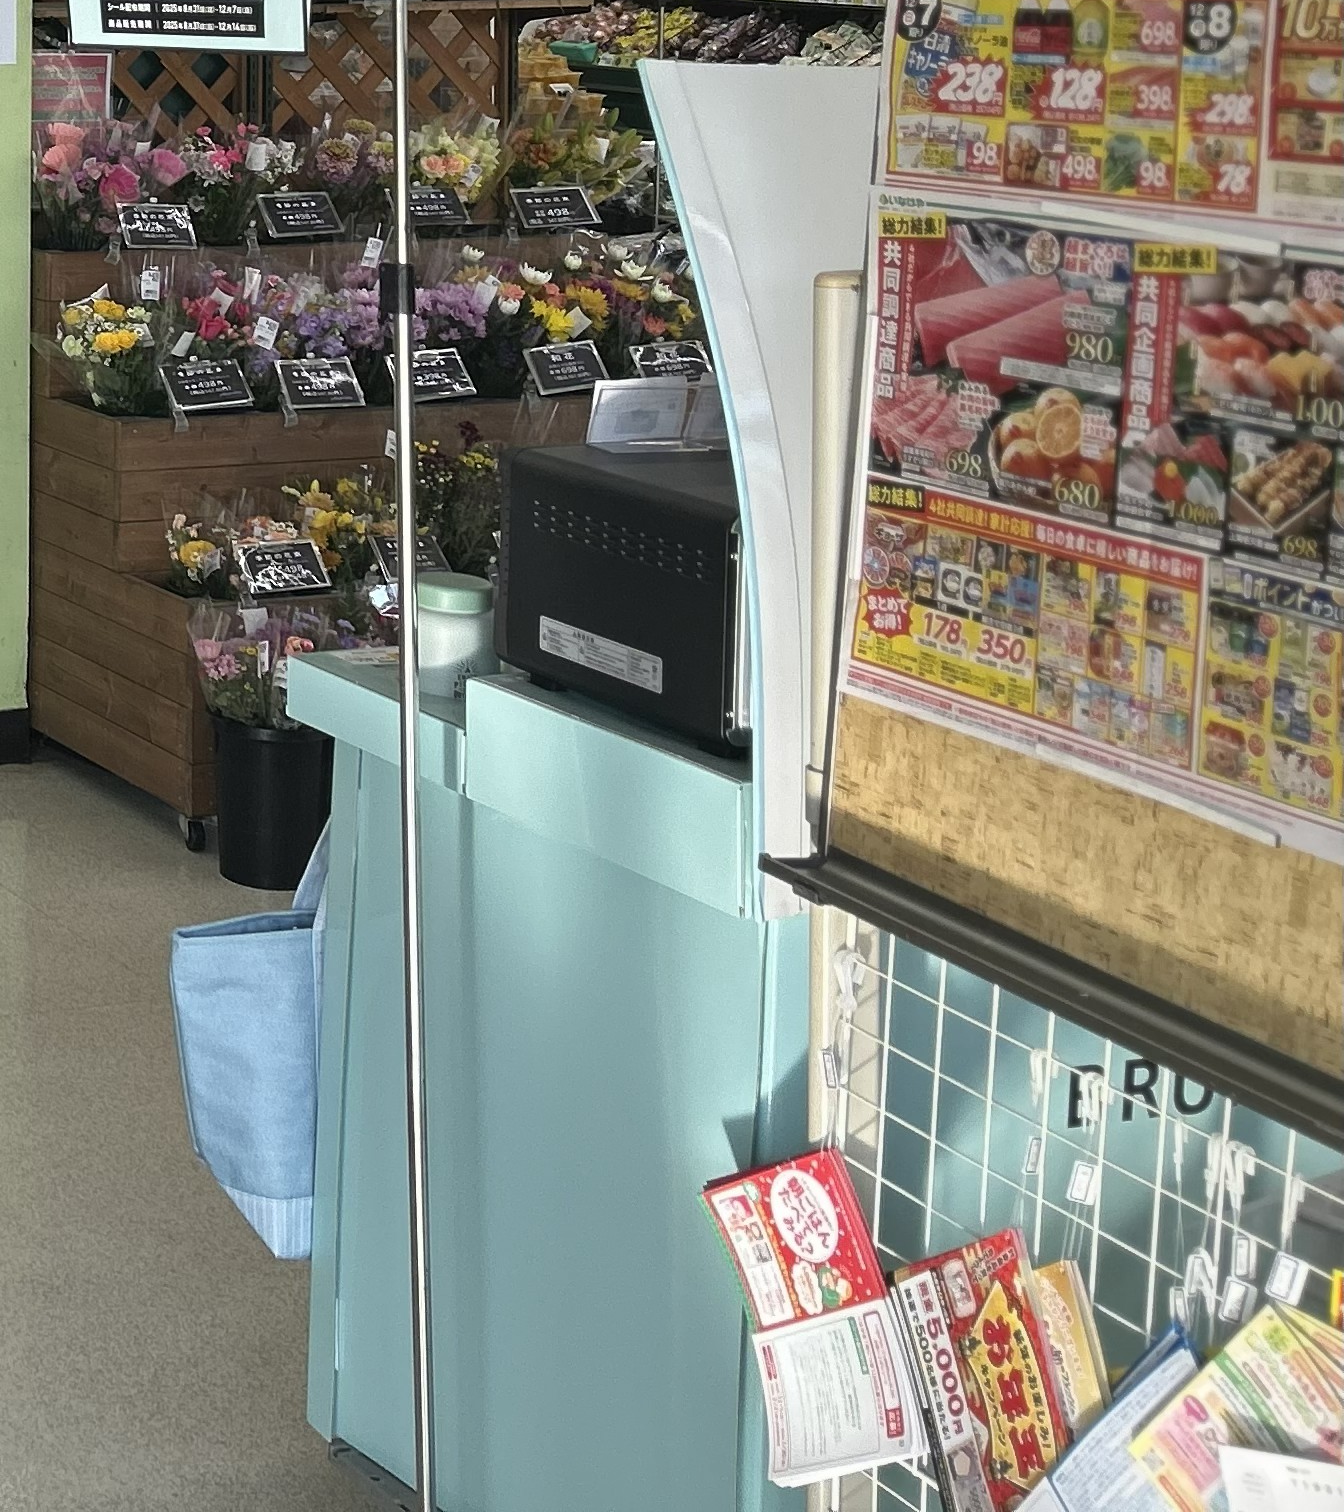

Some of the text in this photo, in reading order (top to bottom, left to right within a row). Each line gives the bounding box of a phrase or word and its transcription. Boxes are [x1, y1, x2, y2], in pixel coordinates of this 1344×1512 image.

[1141, 20, 1175, 45] 698
[1209, 4, 1232, 37] 8
[924, 34, 950, 53] 日清
[1137, 85, 1172, 111] 398
[973, 143, 1096, 179] 98 498
[1140, 161, 1251, 193] 98 78
[882, 217, 943, 236] 総力結集!
[1138, 248, 1213, 270] 総力結集!
[1065, 332, 1112, 363] 980
[946, 450, 983, 477] 698
[1055, 477, 1100, 509] 680
[867, 592, 907, 614] まとめて
[873, 613, 903, 630] お得!
[923, 612, 1026, 665] 178 350
[982, 1314, 1046, 1480] お年玉
